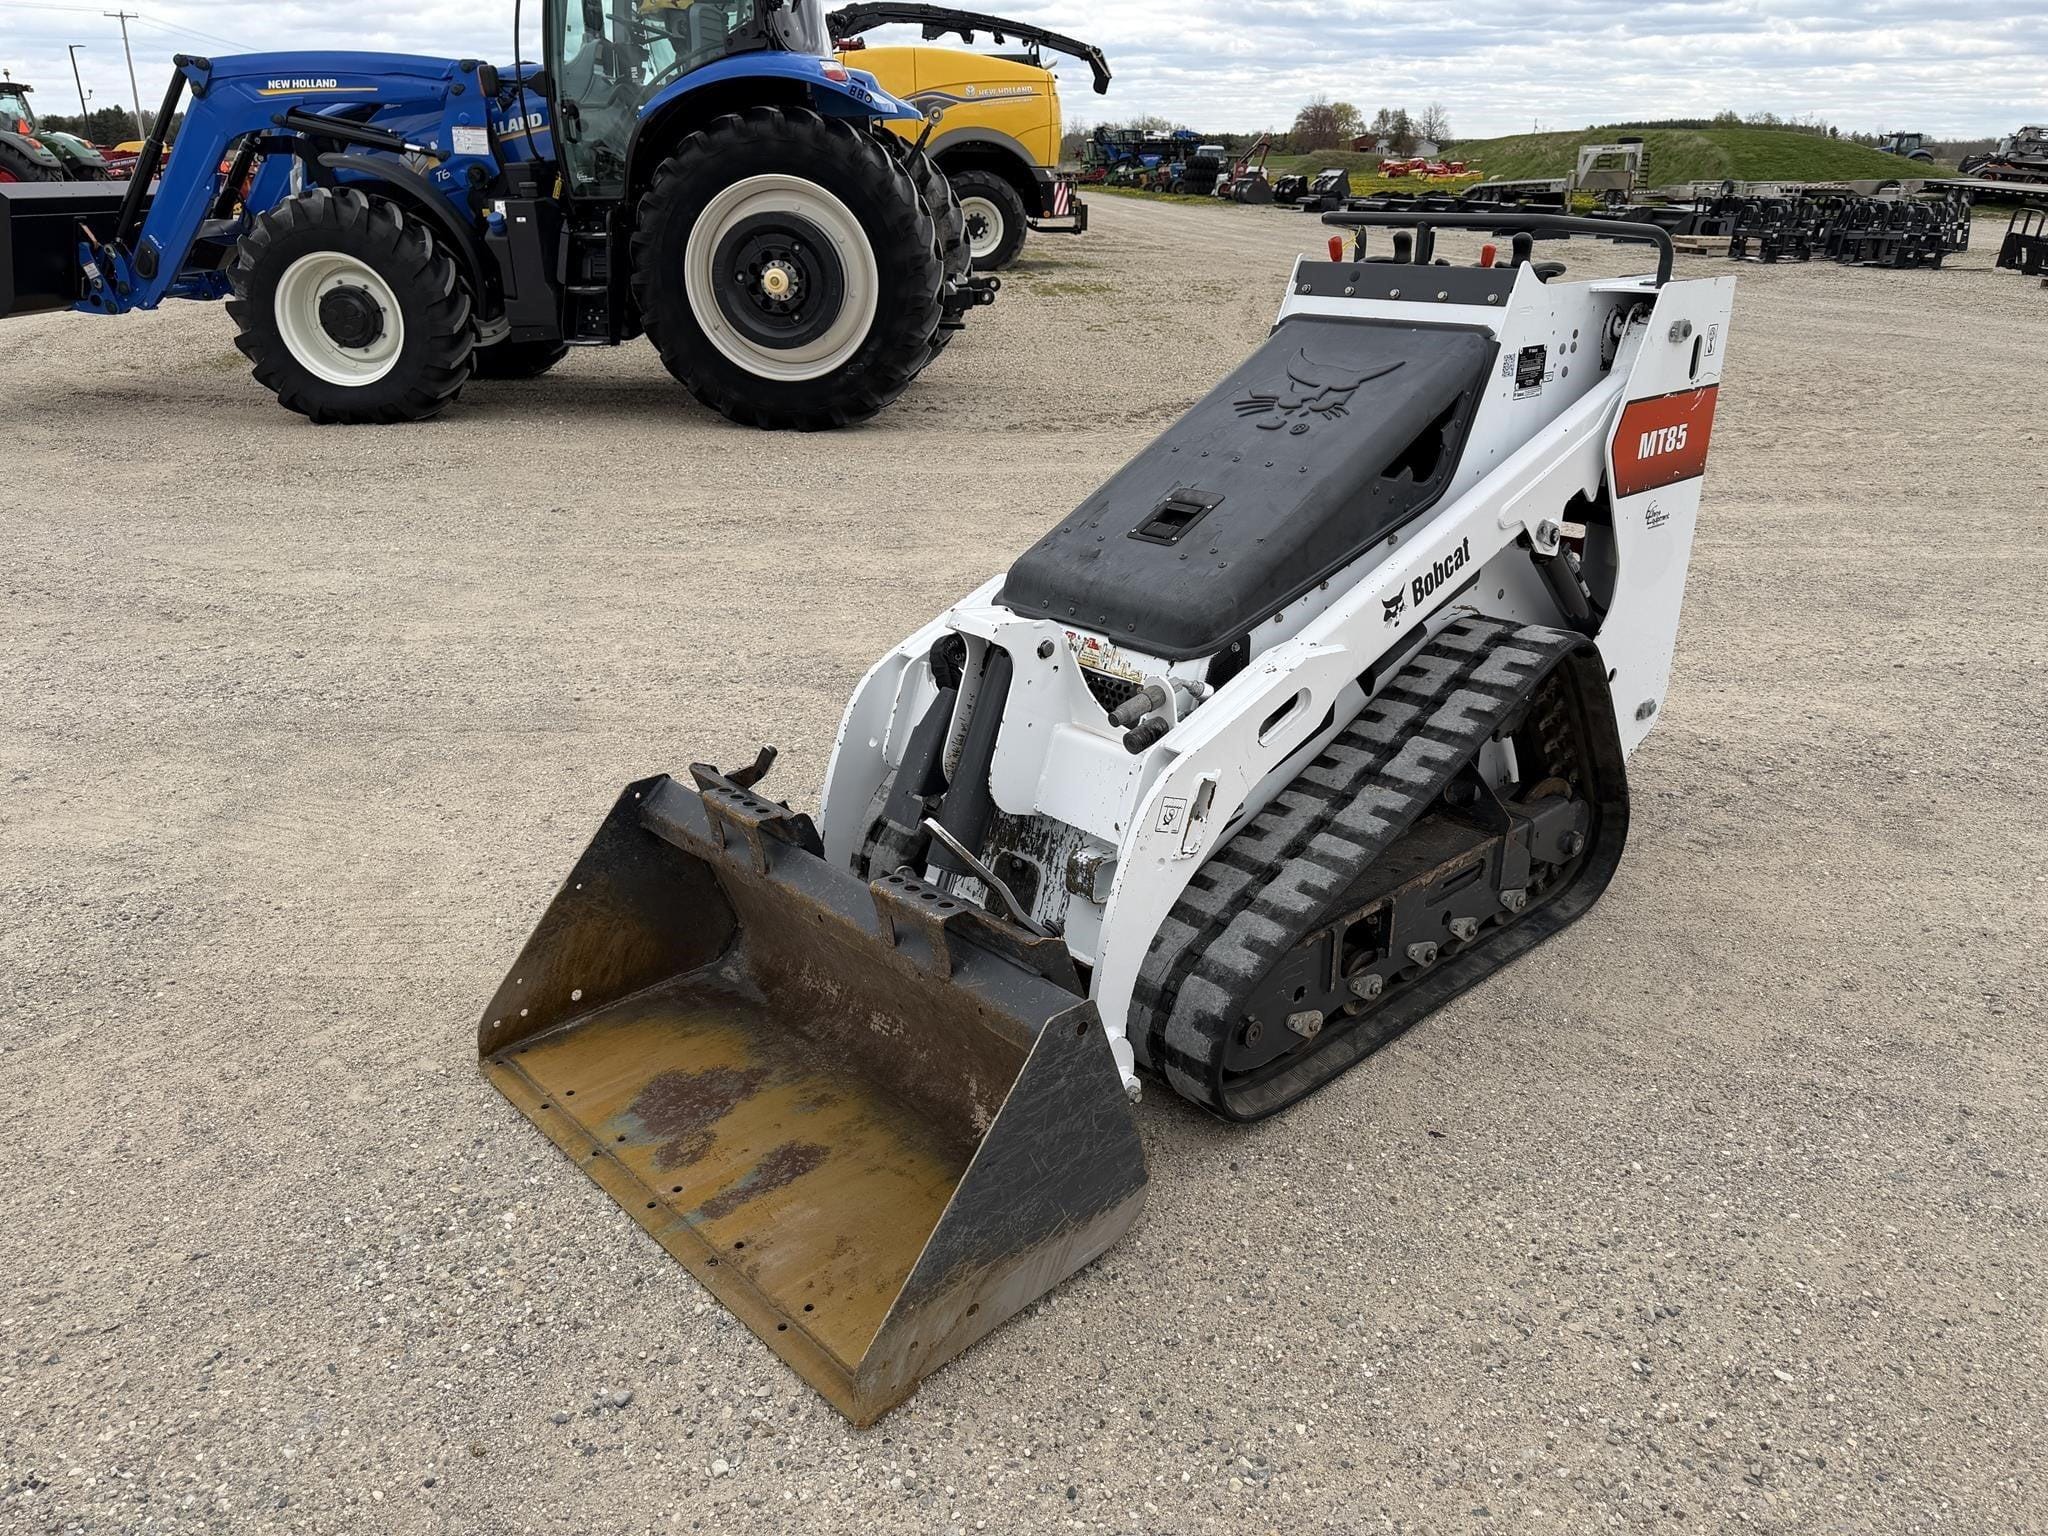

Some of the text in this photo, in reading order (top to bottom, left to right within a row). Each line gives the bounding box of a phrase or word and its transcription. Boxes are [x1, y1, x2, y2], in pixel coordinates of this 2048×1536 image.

[268, 79, 338, 89] NEW HOLLAND
[998, 86, 1033, 94] HOLLAND
[435, 168, 451, 183] T6
[1637, 423, 1689, 460] MT85
[1411, 536, 1470, 608] Bobcat
